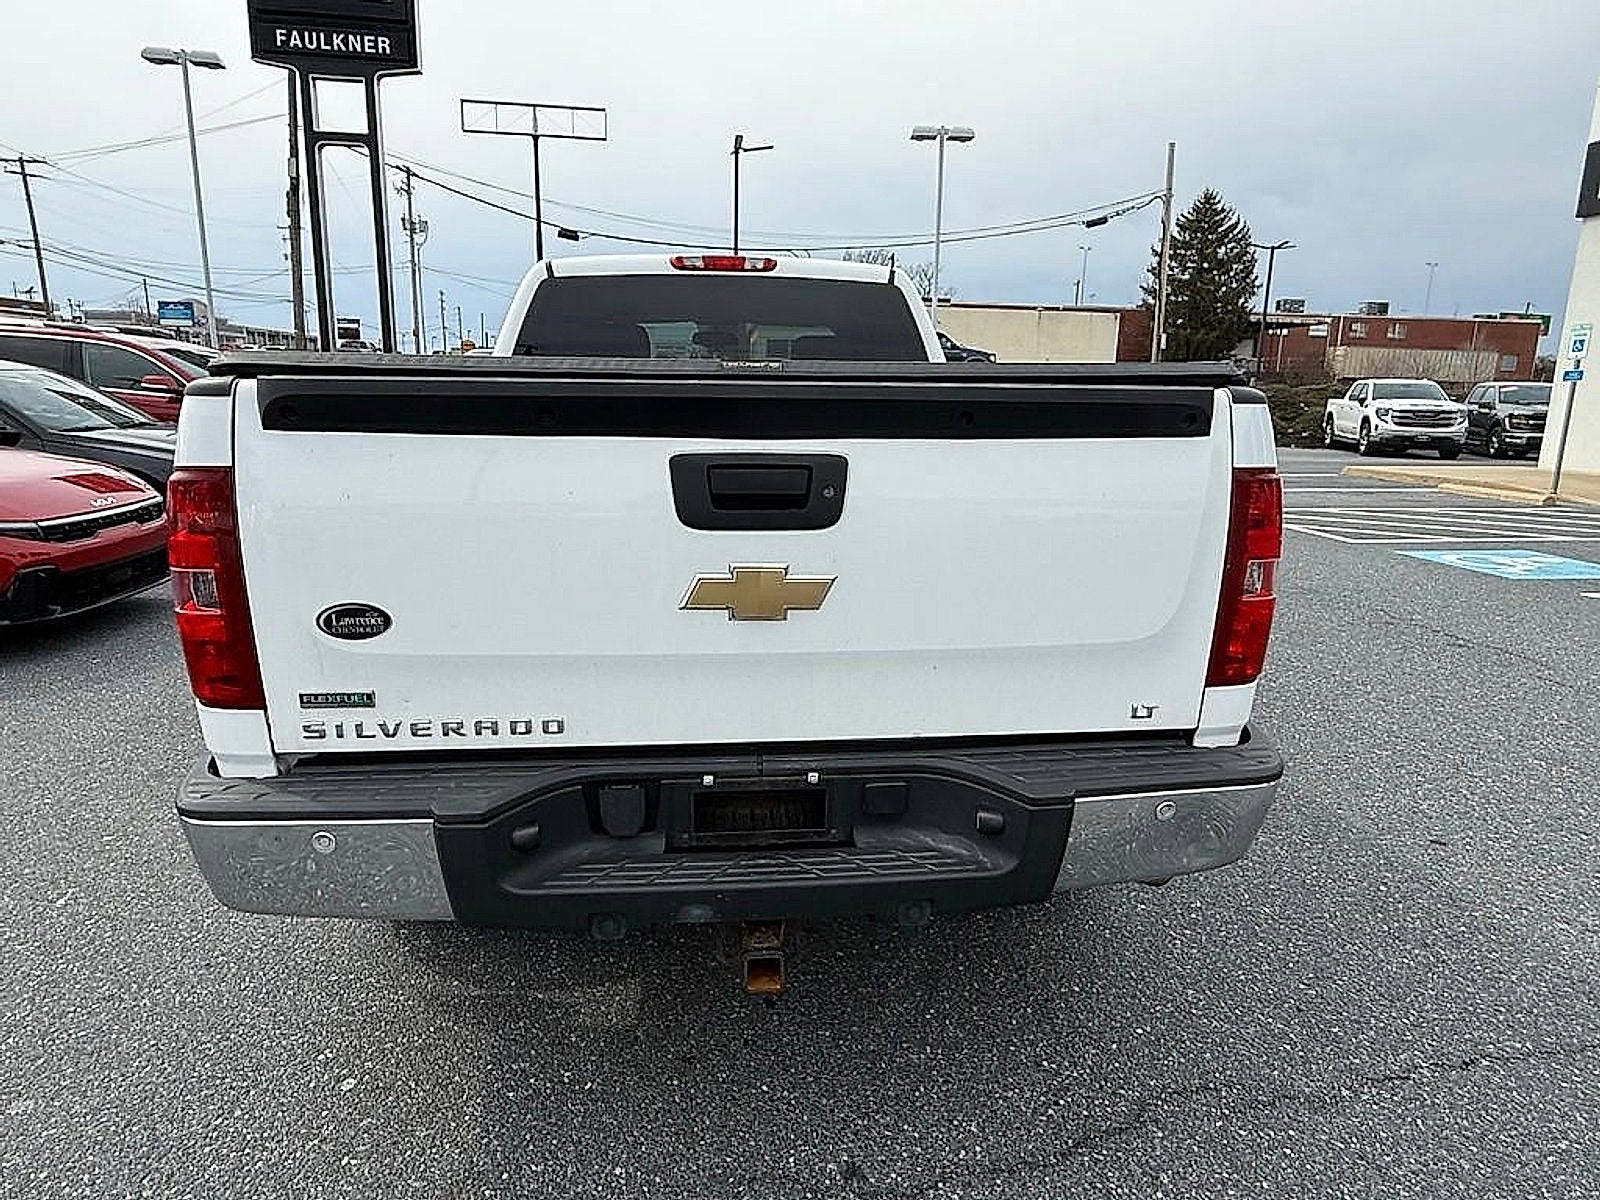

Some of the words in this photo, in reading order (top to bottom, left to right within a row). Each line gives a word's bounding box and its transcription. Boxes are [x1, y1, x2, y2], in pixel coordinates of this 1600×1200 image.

[275, 28, 392, 55] FAULKNER
[331, 613, 385, 626] Lawrence
[302, 694, 372, 704] FLEXFUEL
[1131, 703, 1160, 719] LT
[302, 716, 566, 740] SILVERADO
